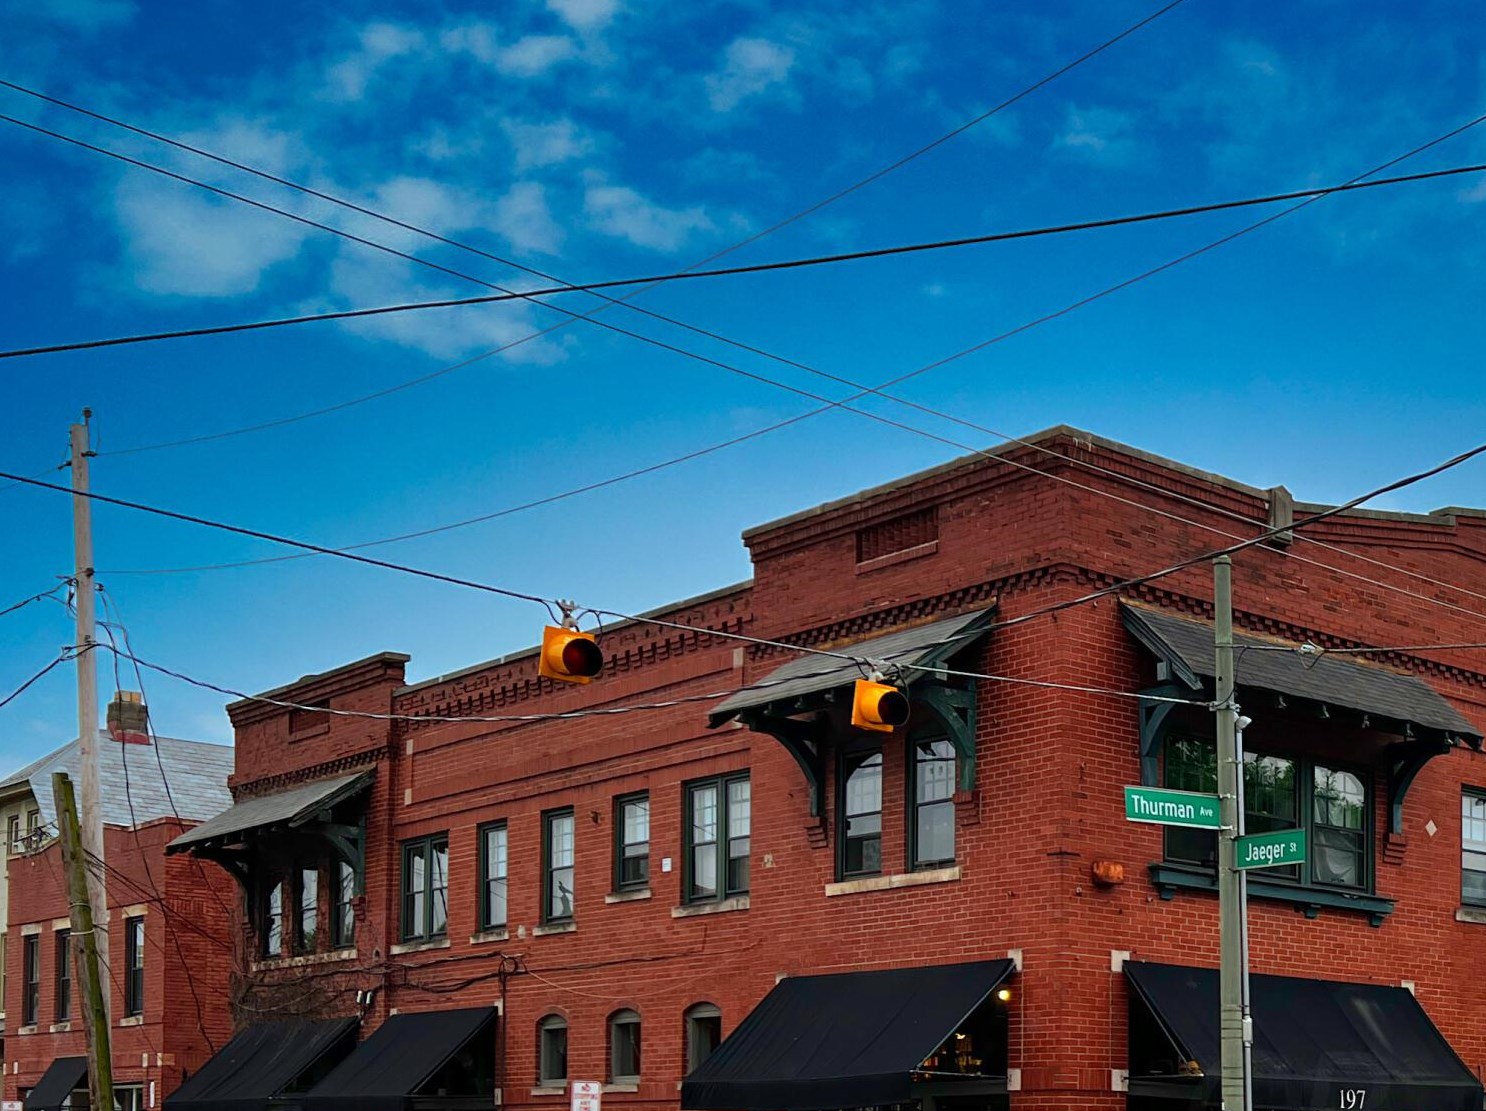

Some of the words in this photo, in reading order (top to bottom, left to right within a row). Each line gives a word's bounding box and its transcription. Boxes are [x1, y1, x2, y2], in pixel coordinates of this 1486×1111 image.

[1131, 794, 1194, 819] Thurman
[1200, 805, 1213, 818] Ave
[1245, 842, 1286, 865] Jaeger
[1289, 842, 1297, 853] St
[1340, 1089, 1366, 1110] 197
